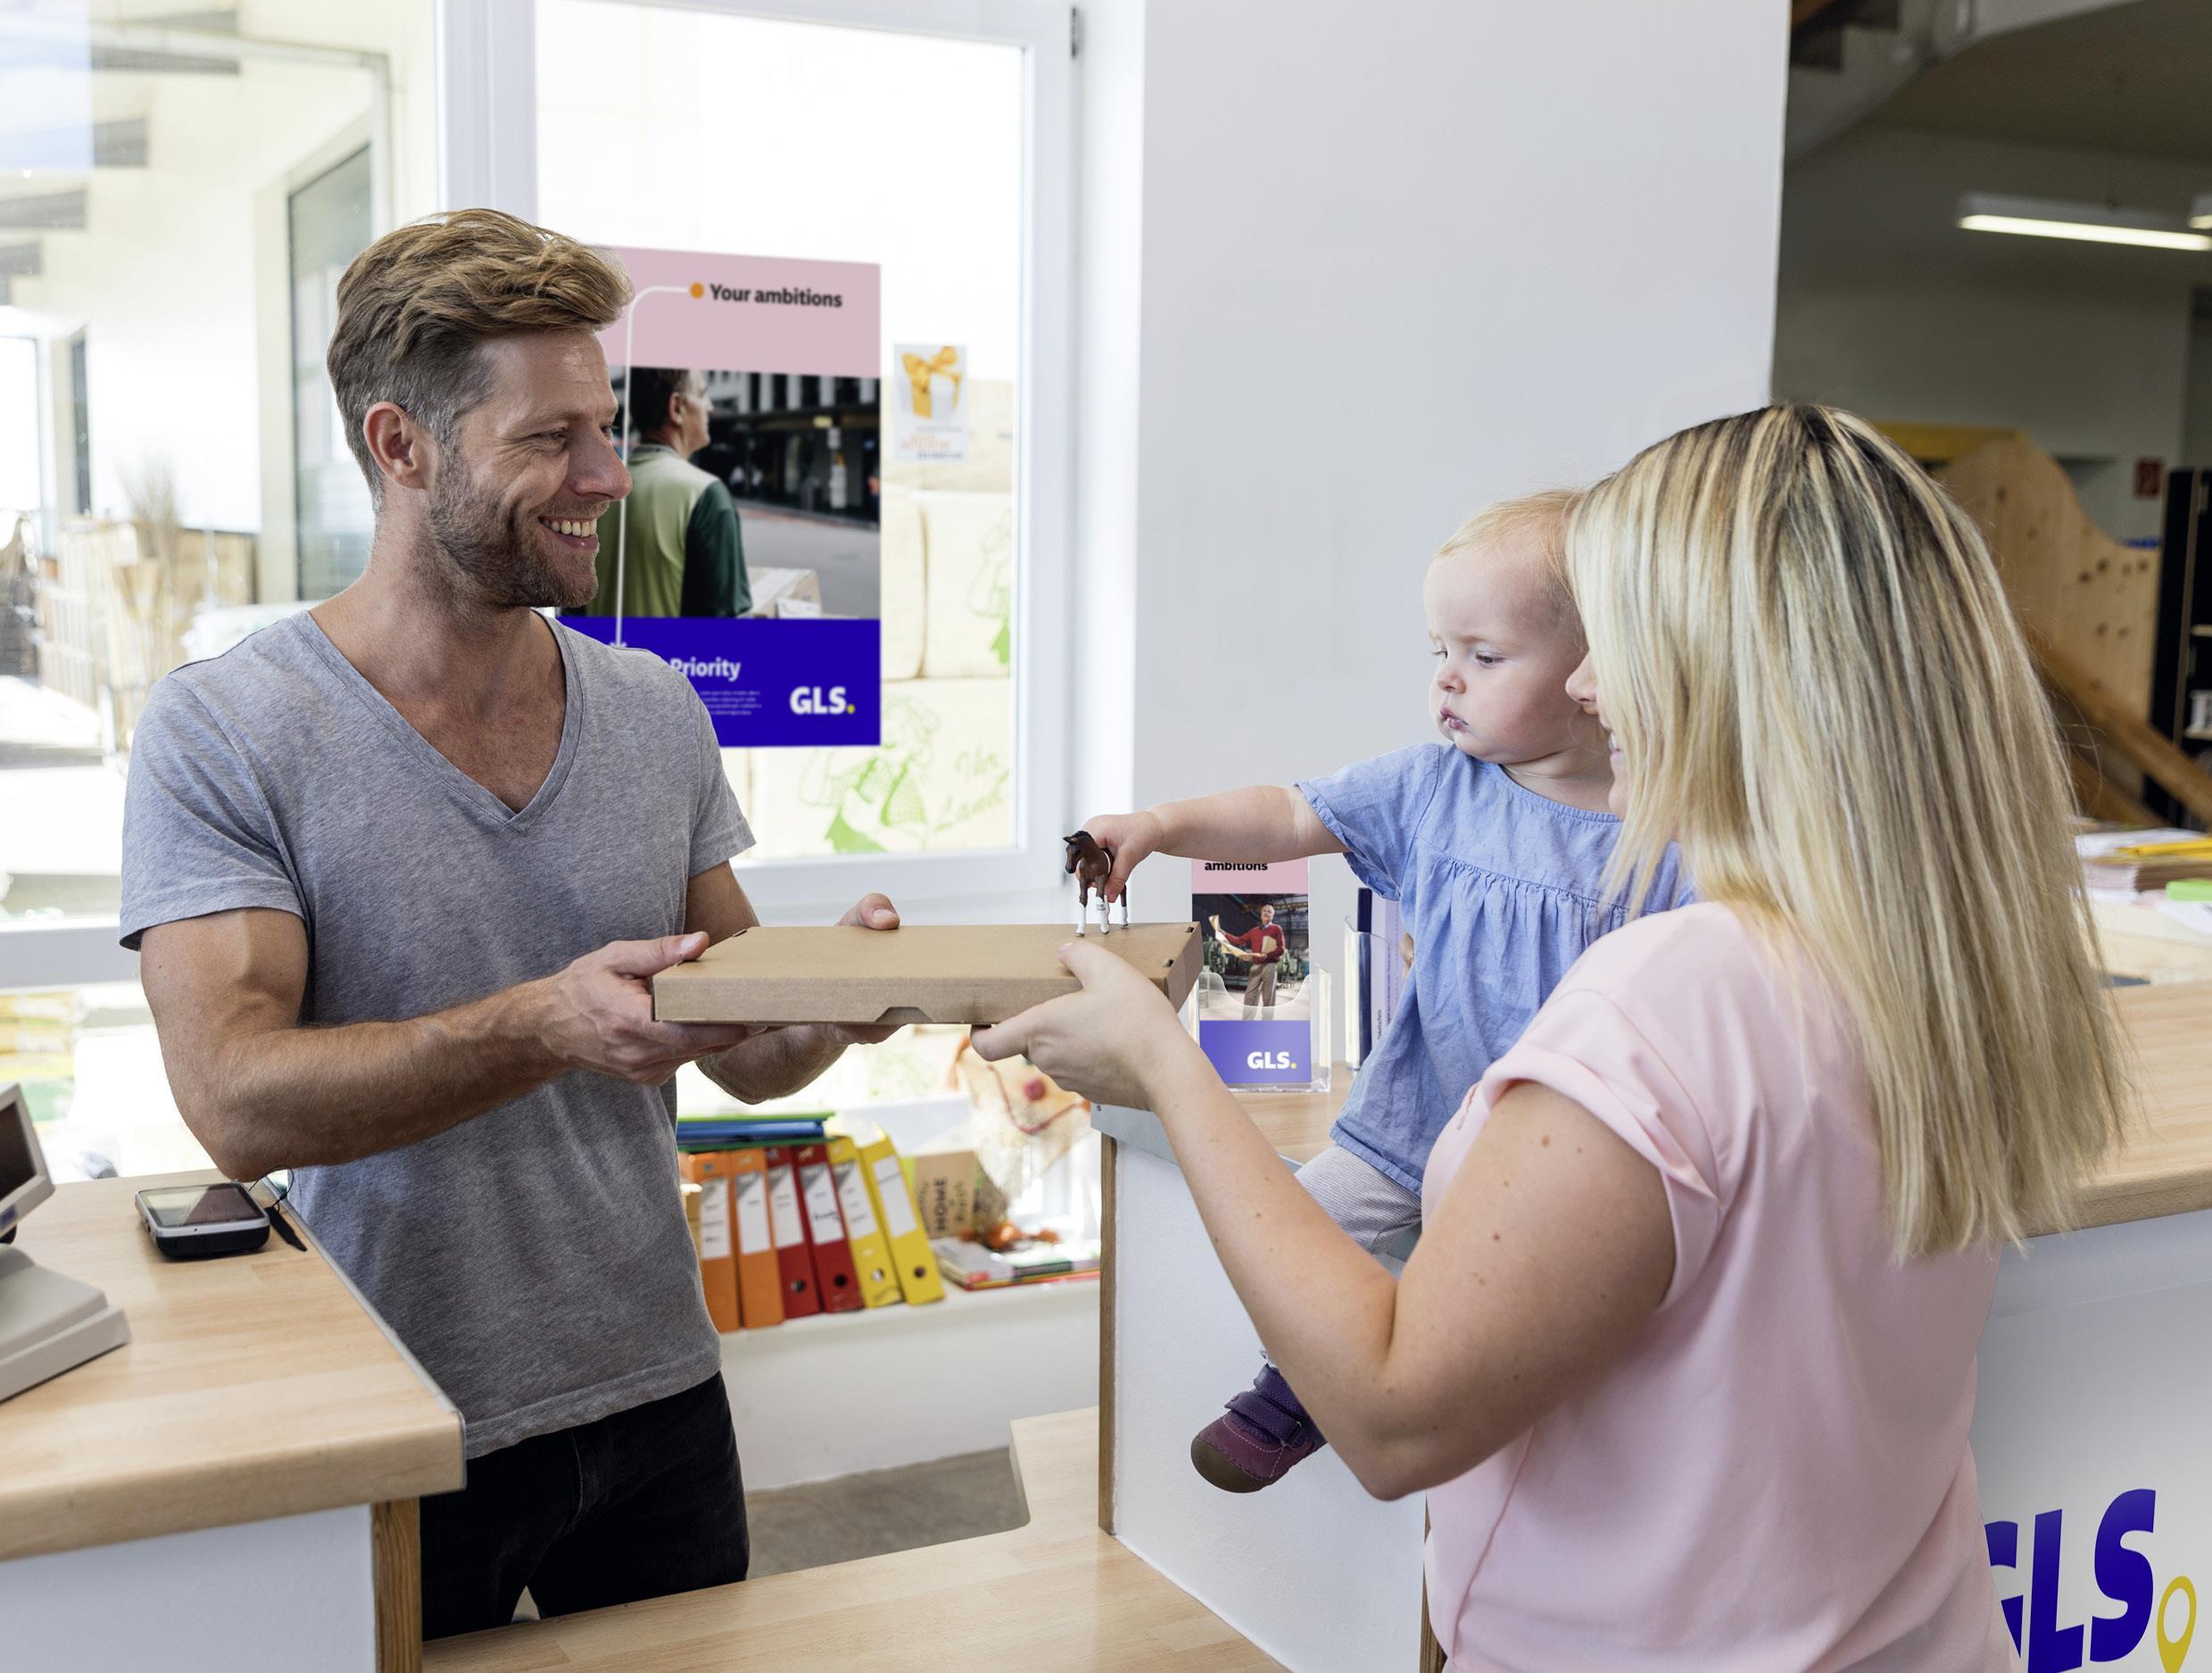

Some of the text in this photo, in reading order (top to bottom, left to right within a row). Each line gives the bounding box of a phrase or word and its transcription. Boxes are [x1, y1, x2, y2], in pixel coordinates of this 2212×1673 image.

[710, 283, 843, 308] Your ambitions
[670, 656, 741, 682] Priority
[934, 1178, 947, 1230] HOME
